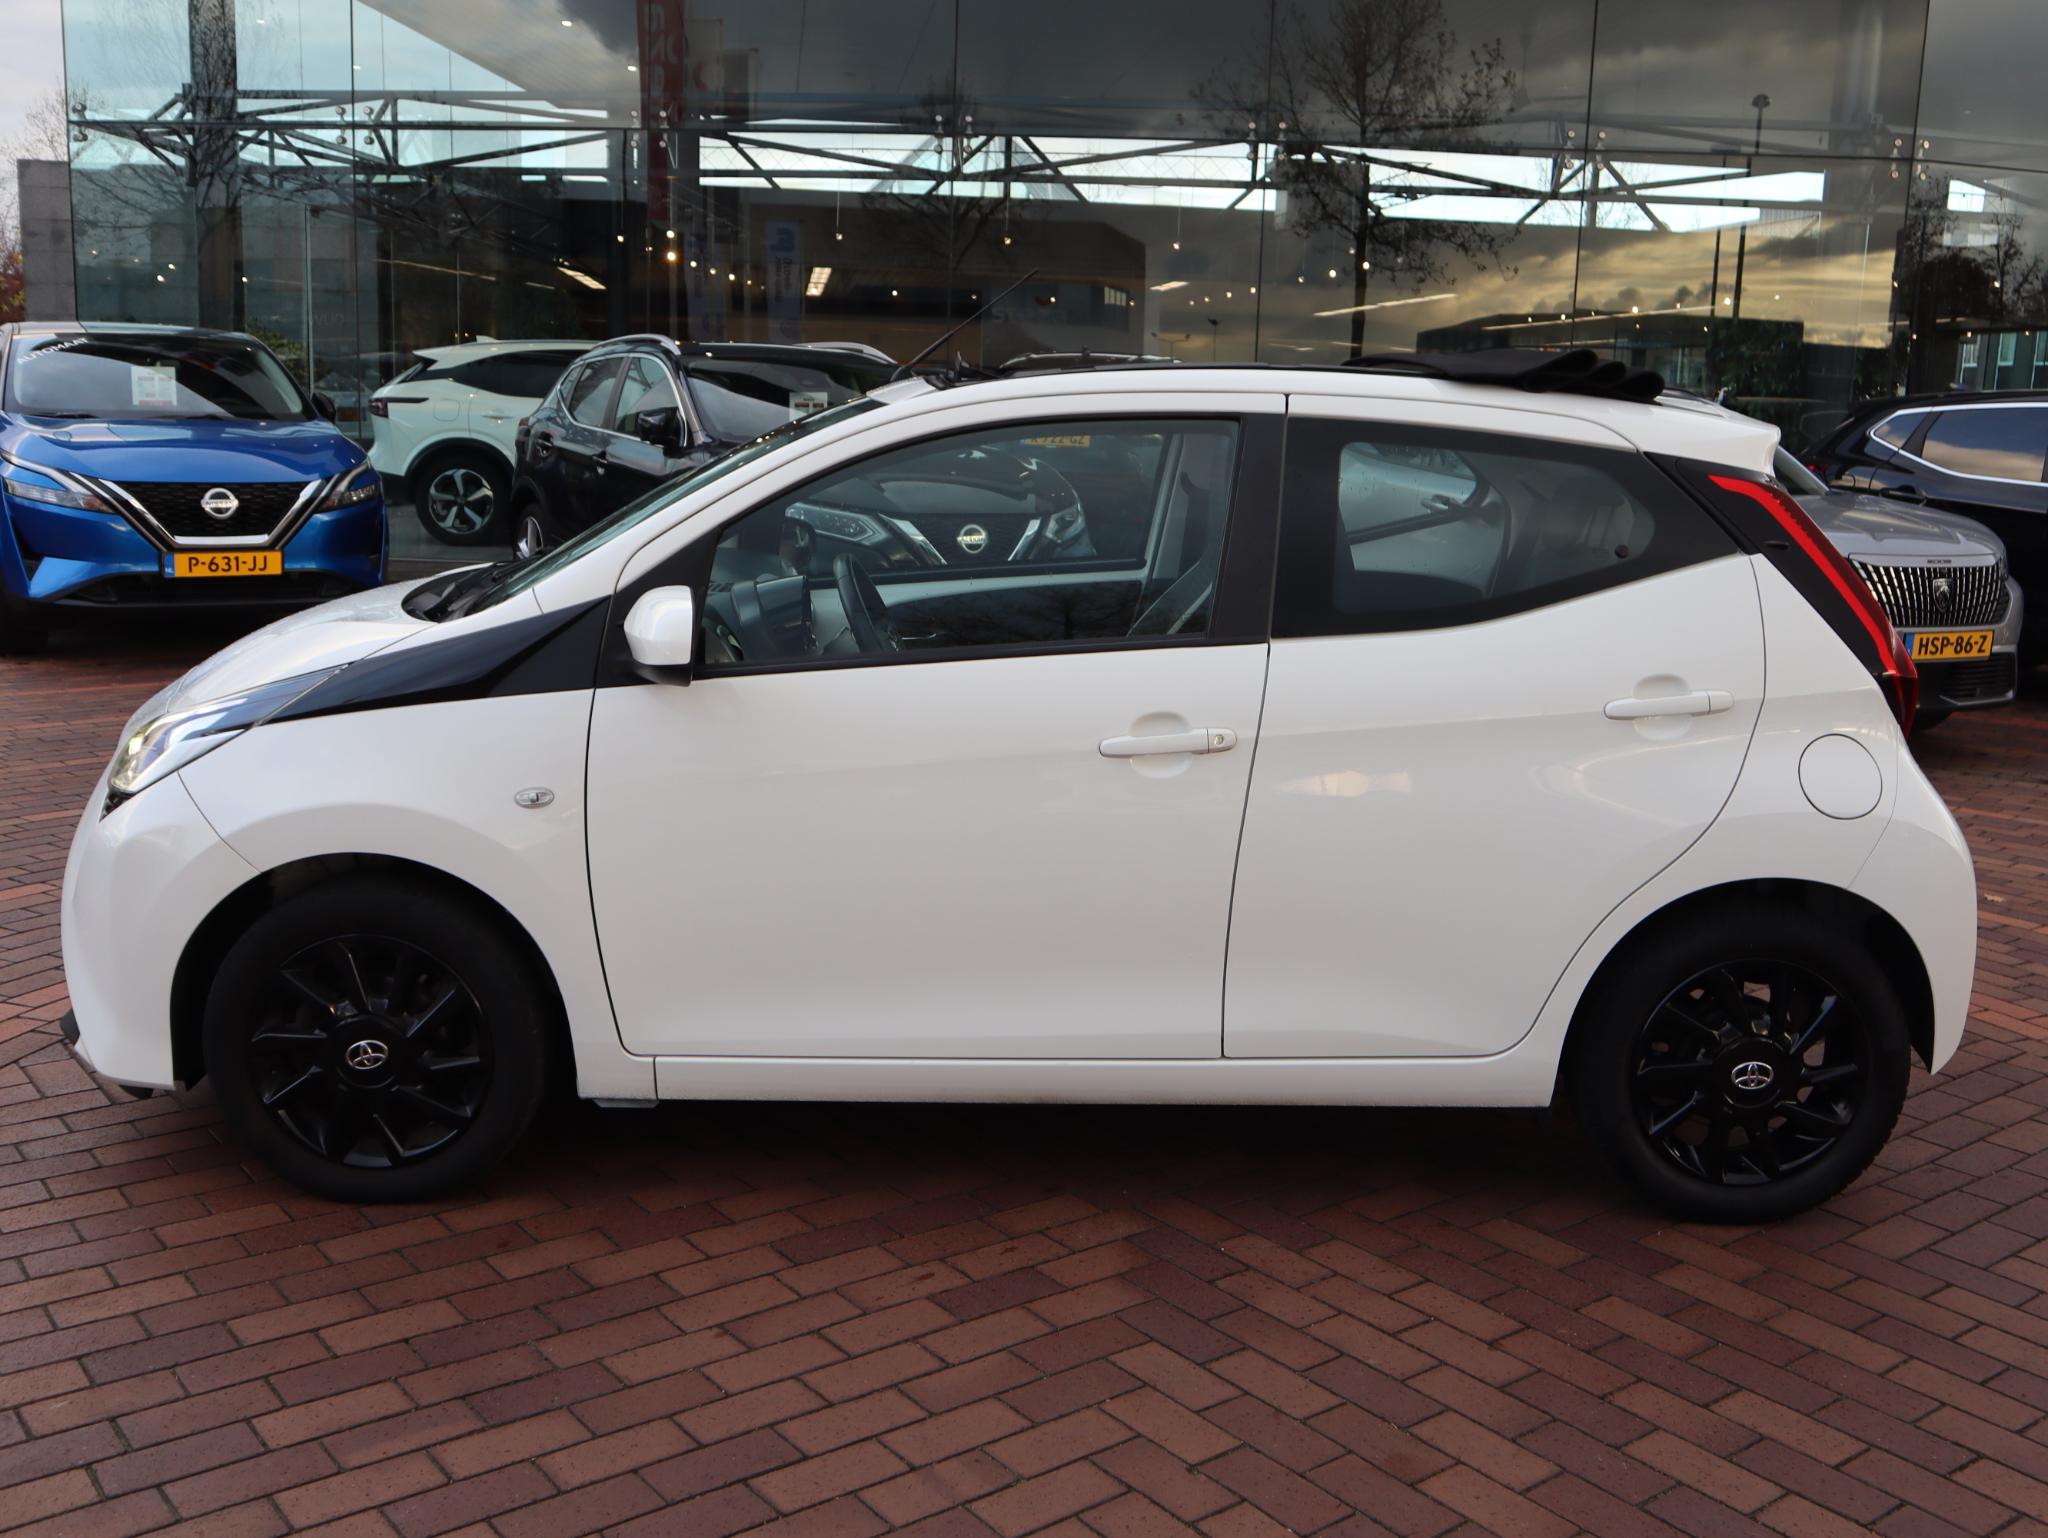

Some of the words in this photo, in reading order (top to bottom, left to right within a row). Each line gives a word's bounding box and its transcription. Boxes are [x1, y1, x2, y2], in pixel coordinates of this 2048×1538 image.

[16, 337, 89, 365] AUTOMAAT
[188, 555, 267, 573] P-631-JJ
[1918, 635, 1988, 656] HSP-86-Z
